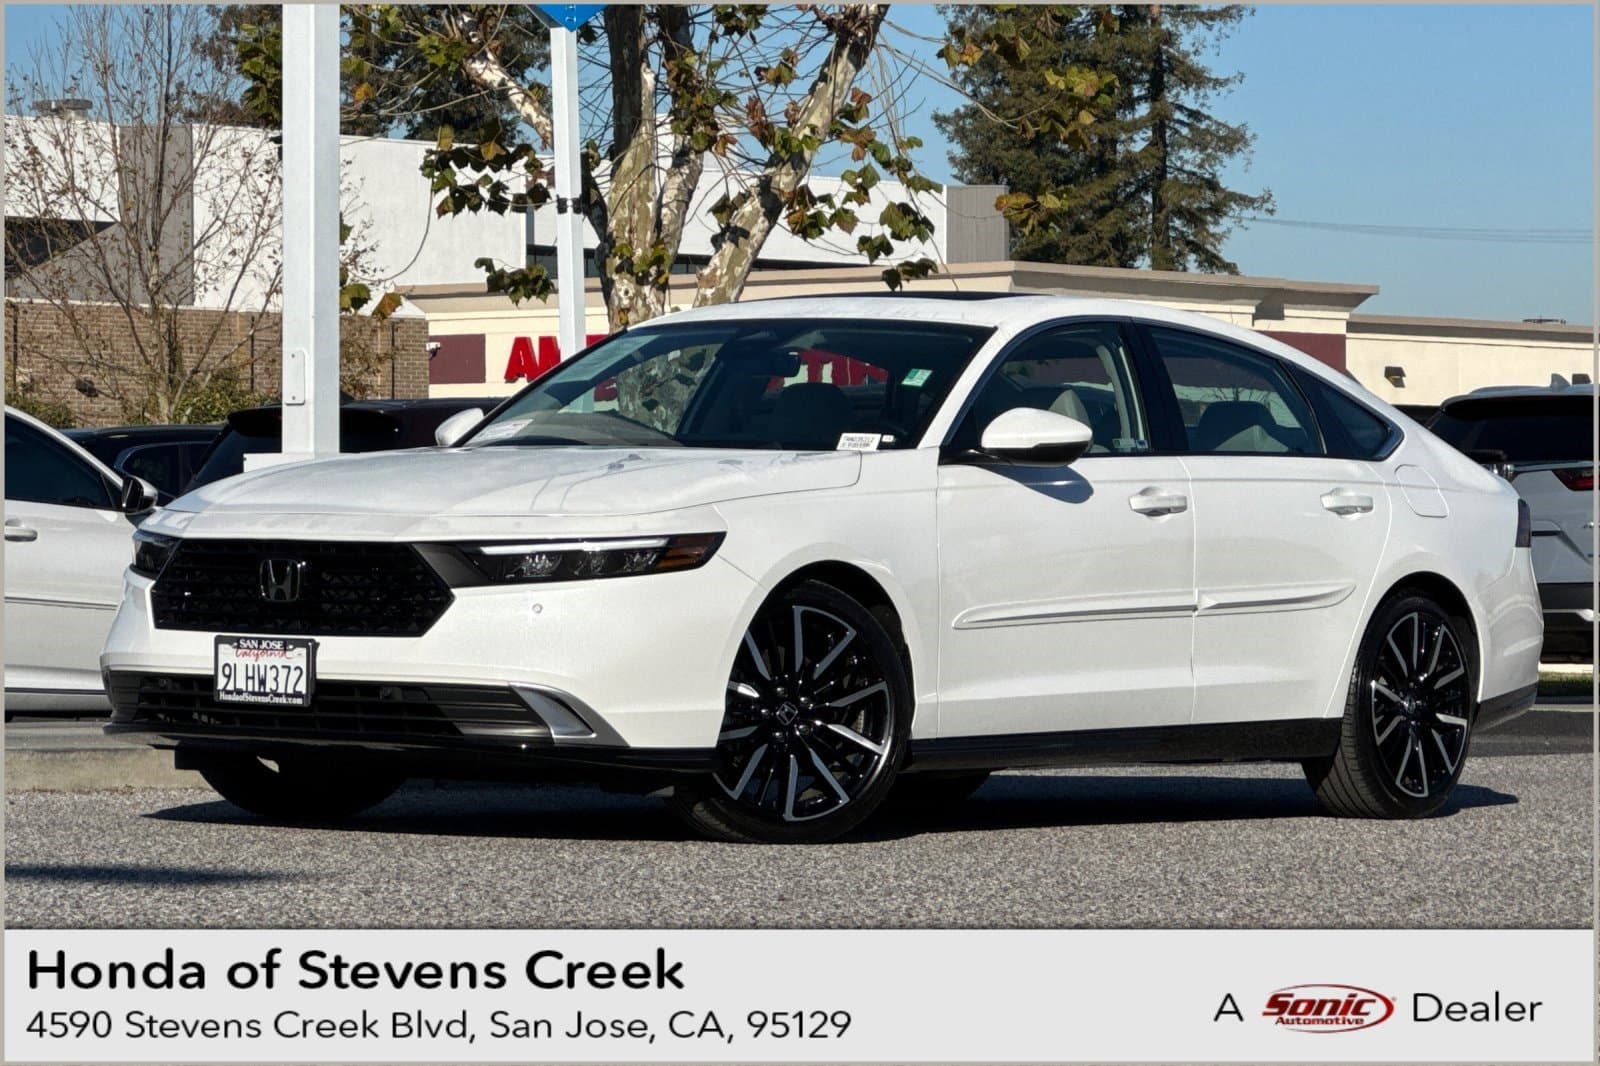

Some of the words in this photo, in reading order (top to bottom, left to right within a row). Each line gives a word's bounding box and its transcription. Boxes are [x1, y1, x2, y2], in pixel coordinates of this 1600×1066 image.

[239, 639, 258, 649] SAN
[260, 640, 284, 650] JOSE
[222, 662, 304, 693] 9LHW372
